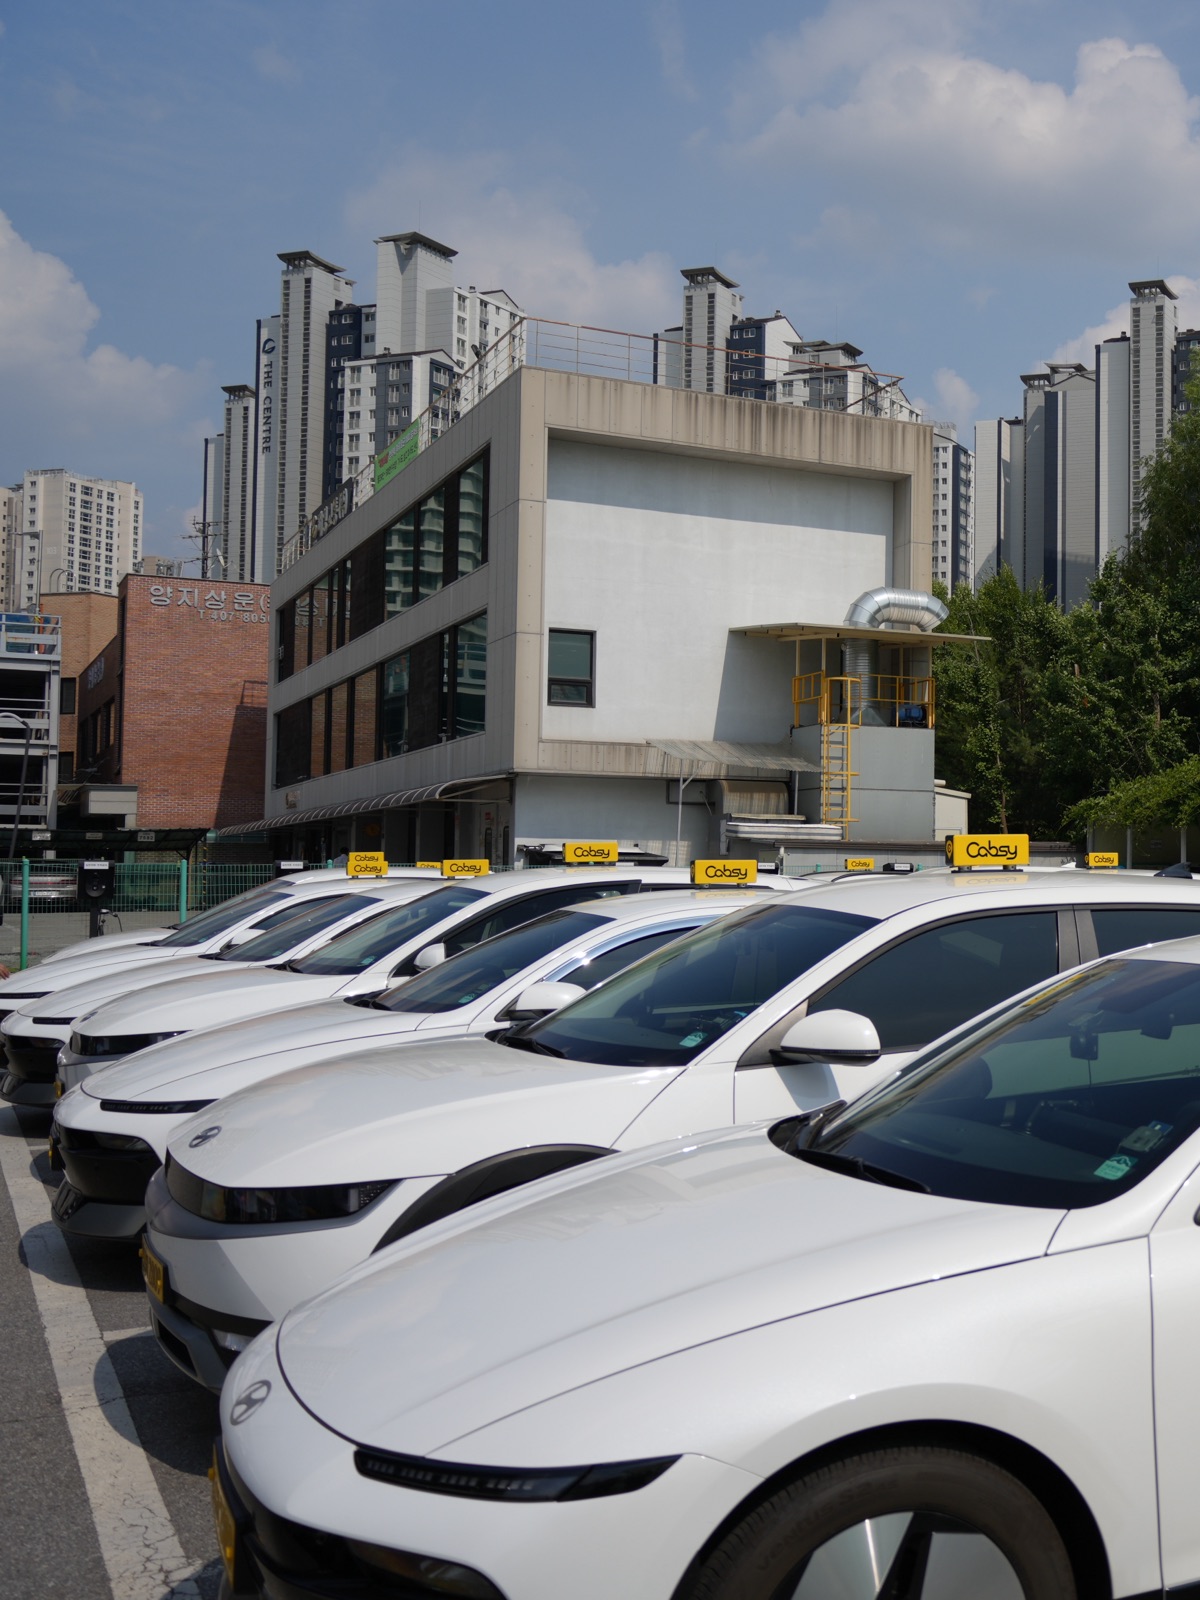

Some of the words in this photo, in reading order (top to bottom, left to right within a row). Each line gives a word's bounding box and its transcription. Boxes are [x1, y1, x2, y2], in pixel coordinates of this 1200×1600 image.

[263, 360, 273, 389] THE
[261, 396, 272, 455] CENTRE
[573, 846, 610, 858] Cabsy
[966, 840, 1017, 859] Cabsy
[1094, 855, 1115, 864] Cabsy
[353, 864, 382, 873] Cabsy
[449, 862, 482, 873] Cabsy
[705, 865, 747, 880] Cabsy
